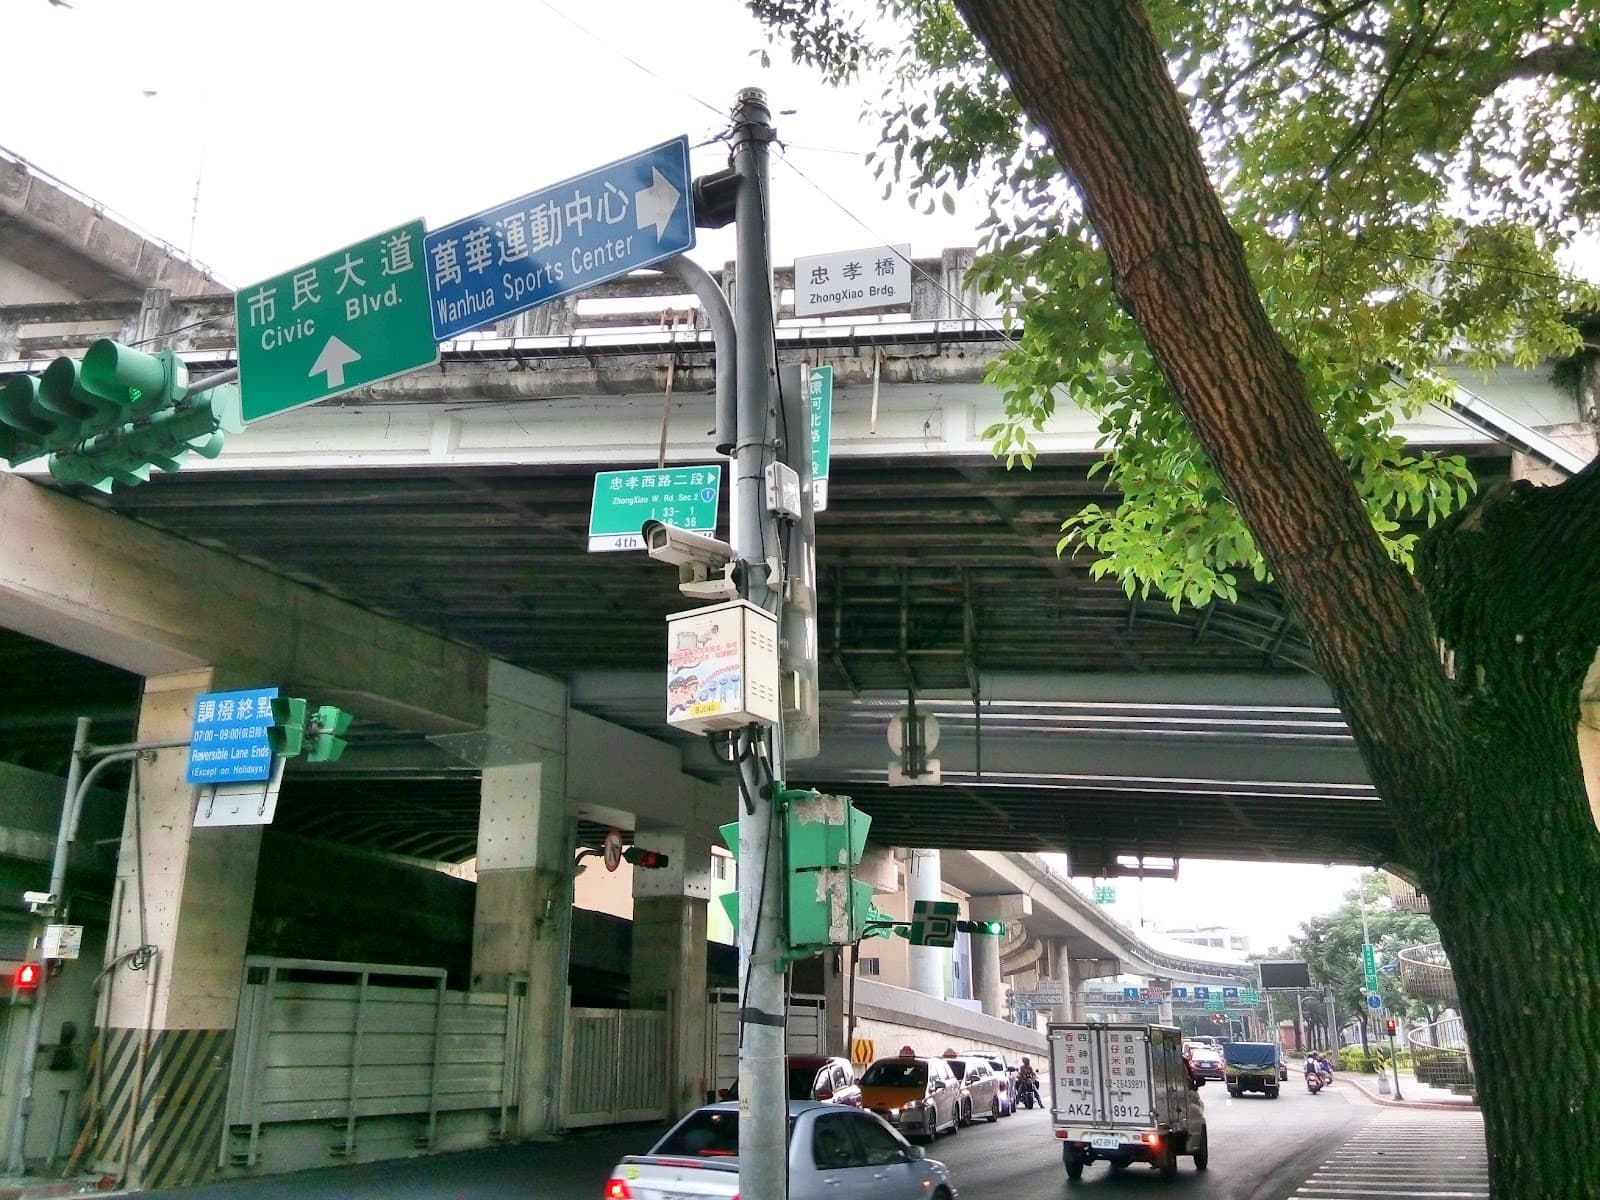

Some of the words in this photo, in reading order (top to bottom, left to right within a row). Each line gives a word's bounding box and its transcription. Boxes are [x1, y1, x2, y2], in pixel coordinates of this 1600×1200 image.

[431, 180, 630, 292] 萬華運動中心
[247, 230, 414, 328] 市民大道
[437, 289, 496, 326] Wanhua
[503, 261, 565, 302] Sports
[570, 233, 634, 273] Center
[810, 257, 895, 285] 忠孝橋
[809, 289, 864, 304] ZhongXiao
[261, 317, 316, 351] Civic
[345, 285, 403, 322] Blvd.
[609, 472, 705, 490] 忠孝西路二段
[685, 517, 697, 527] 36
[614, 537, 637, 547] 4th
[197, 696, 273, 723] 調撥終點
[192, 747, 228, 761] Reversible
[231, 748, 248, 759] Lane
[251, 745, 269, 758] Ends
[1068, 1104, 1091, 1116] AKZ
[1113, 1104, 1140, 1118] 8912
